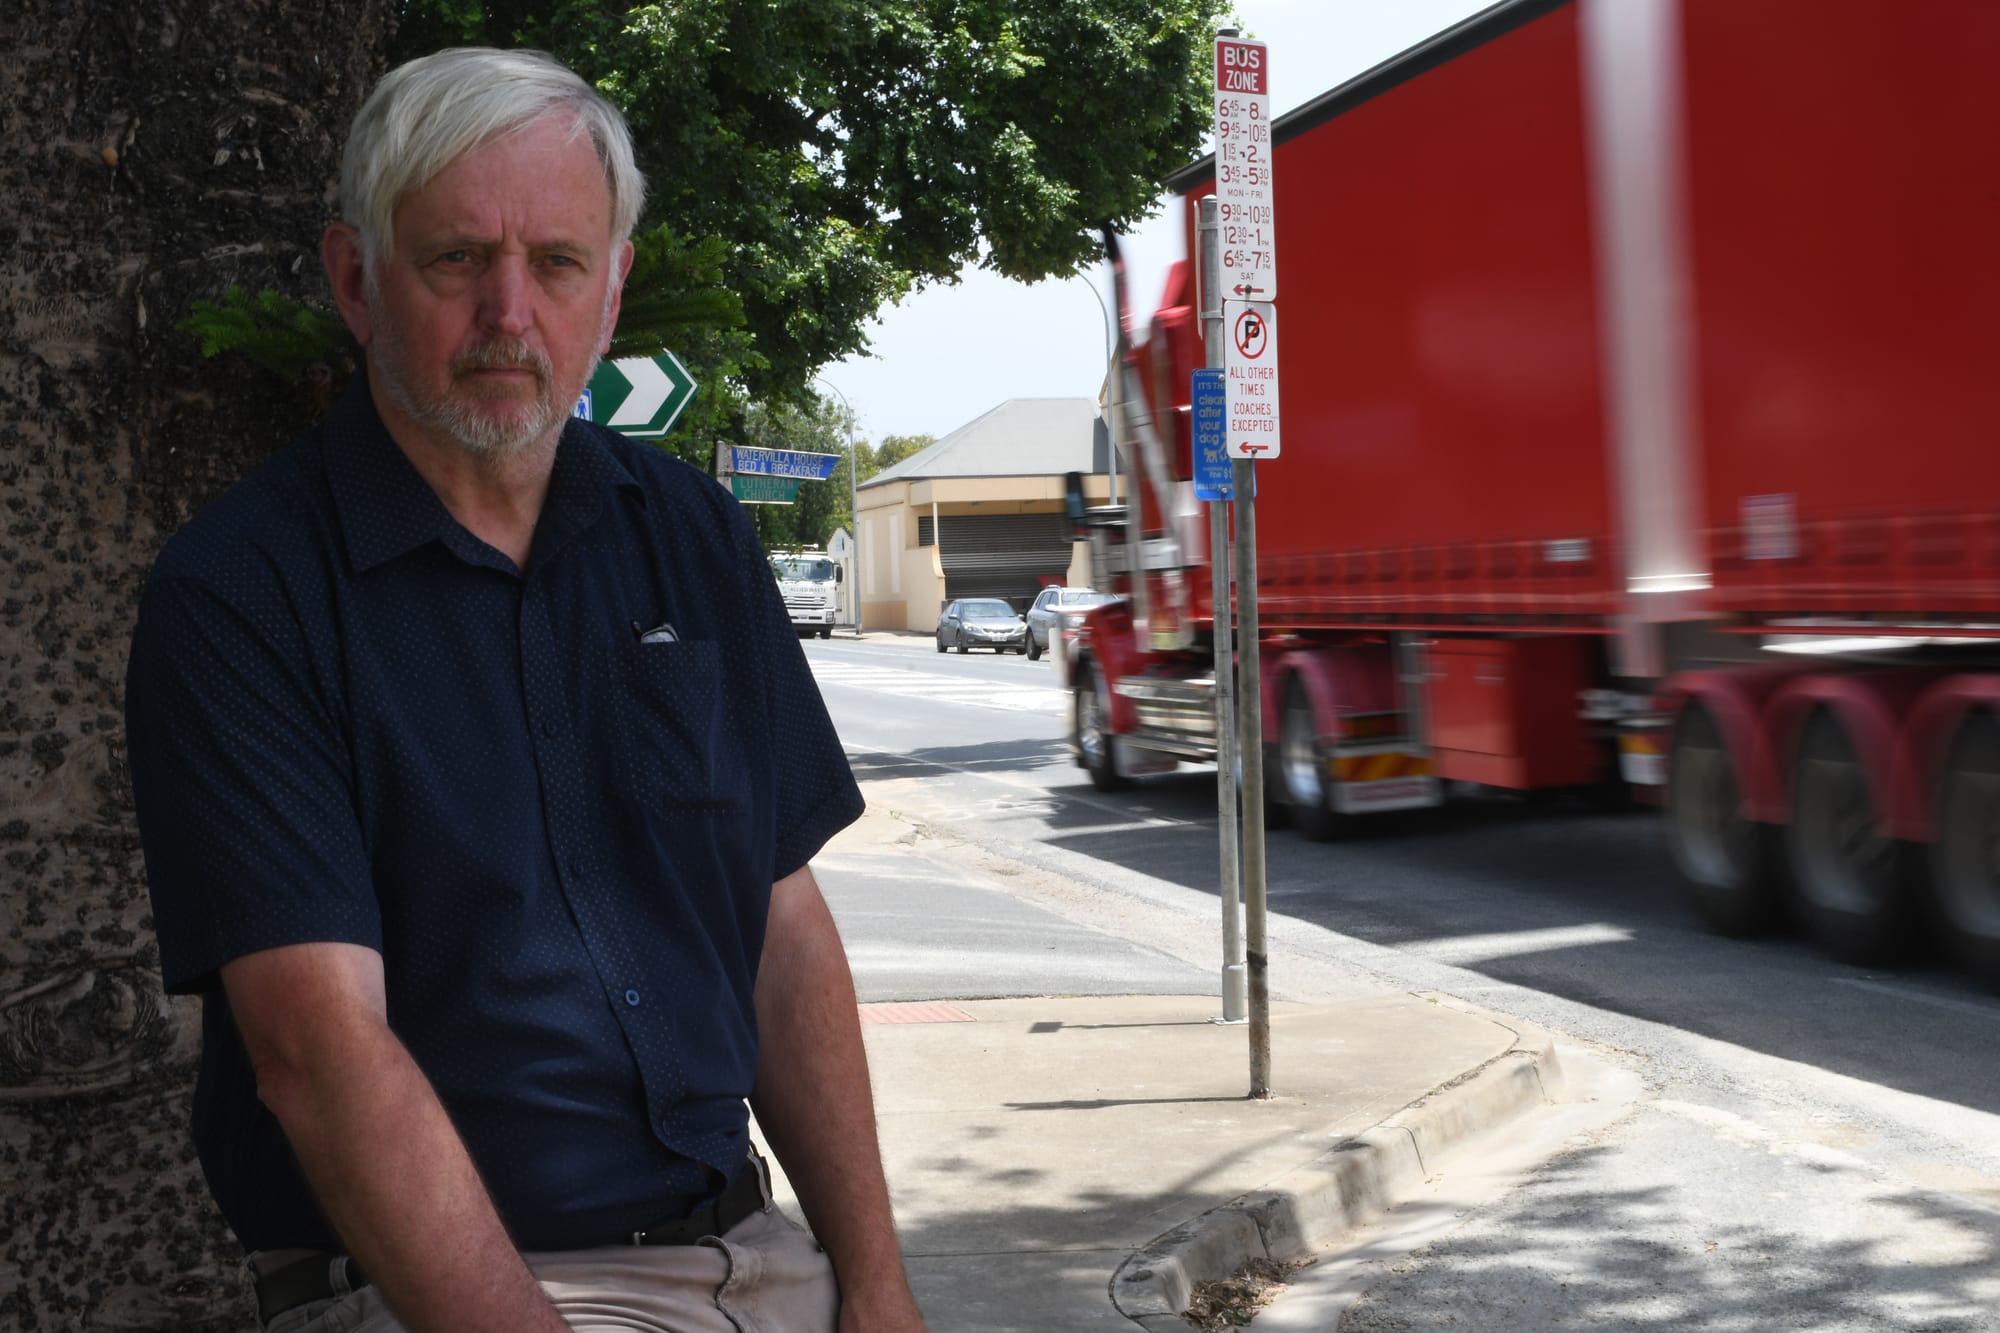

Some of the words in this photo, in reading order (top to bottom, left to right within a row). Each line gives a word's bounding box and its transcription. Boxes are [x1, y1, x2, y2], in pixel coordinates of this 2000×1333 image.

[1224, 46, 1260, 69] BUS
[1226, 70, 1259, 91] ZONE
[1240, 272, 1255, 280] SAT
[1230, 366, 1245, 379] ALL
[1248, 367, 1274, 380] OTHER
[1240, 383, 1265, 396] TIMES
[1199, 406, 1221, 418] after
[1234, 402, 1271, 415] COACHES
[1199, 421, 1220, 432] your
[1232, 420, 1274, 432] EXCEPTED
[1199, 433, 1219, 445] dog
[736, 449, 789, 465] WATERVILLA
[793, 453, 824, 468] HOUSE
[737, 459, 756, 472] BED
[760, 462, 766, 473] &
[771, 462, 821, 477] BREAKFAST
[740, 478, 794, 489] LUTHERAN
[744, 489, 785, 500] CHURCH
